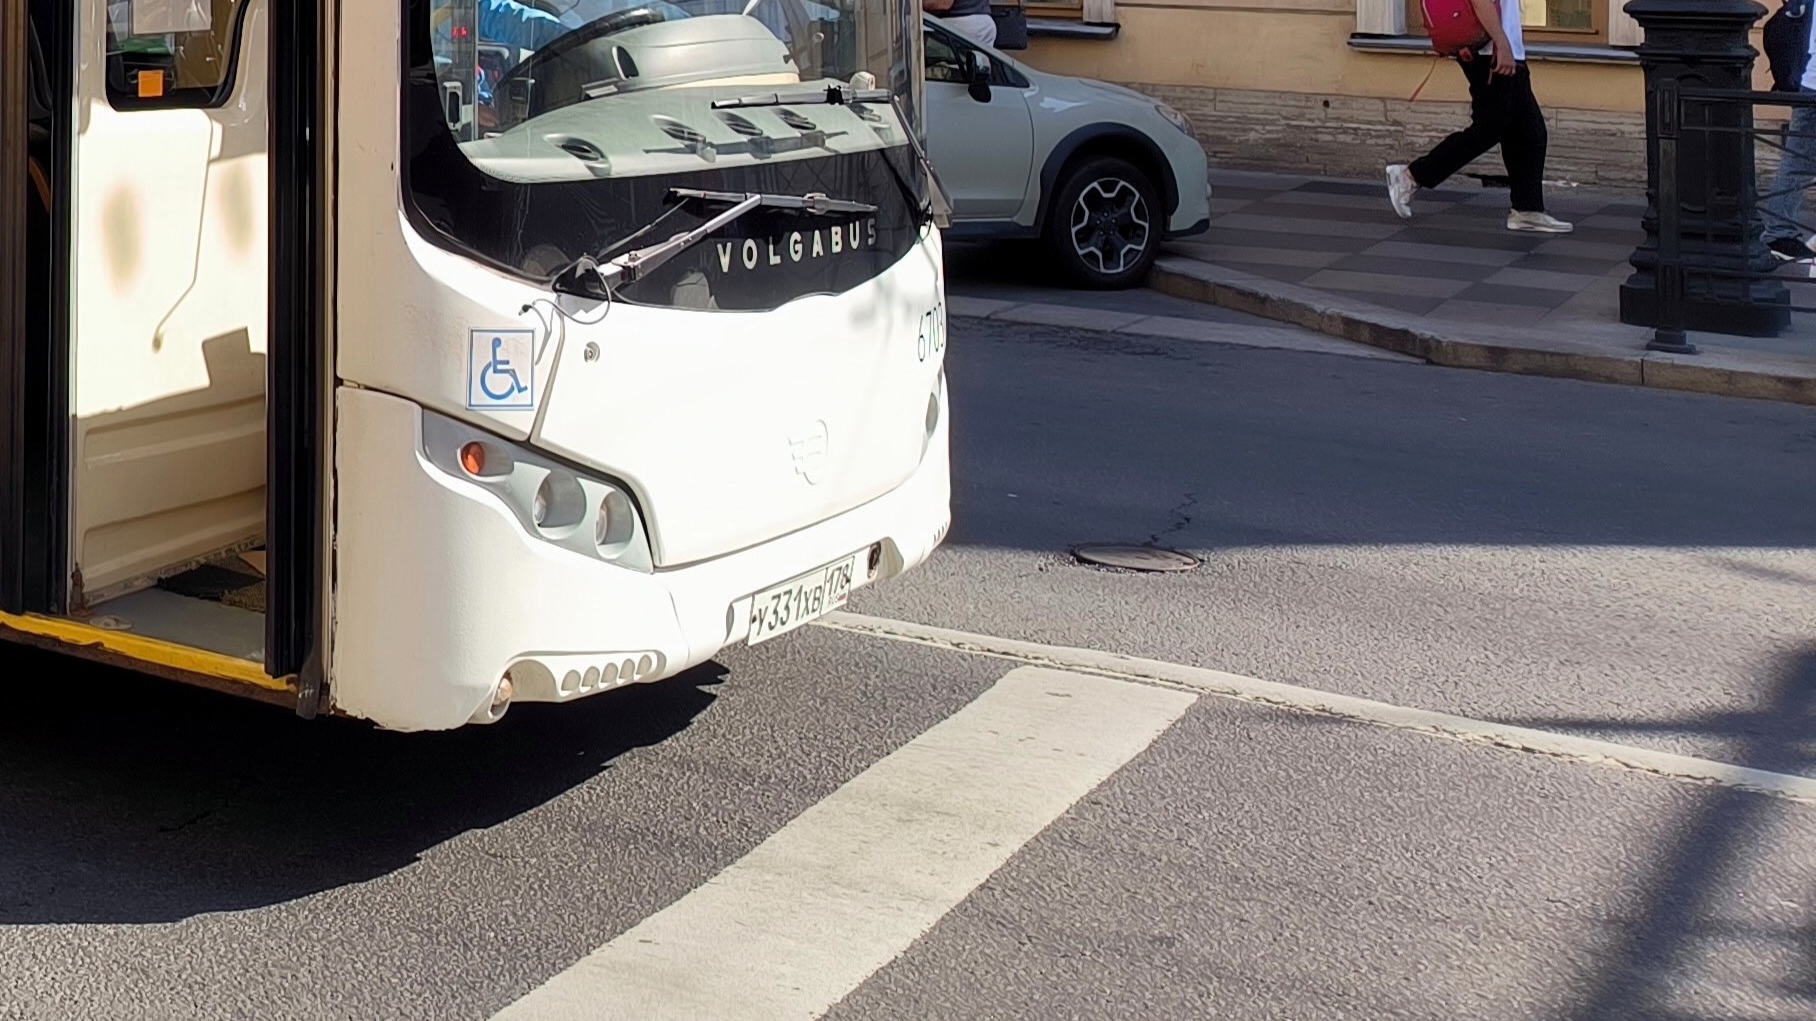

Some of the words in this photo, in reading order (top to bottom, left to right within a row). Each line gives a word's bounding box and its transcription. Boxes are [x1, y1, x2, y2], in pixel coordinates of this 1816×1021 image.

[716, 216, 880, 274] VOLGABUS
[757, 584, 823, 636] У331ХВ
[826, 563, 850, 596] 178
